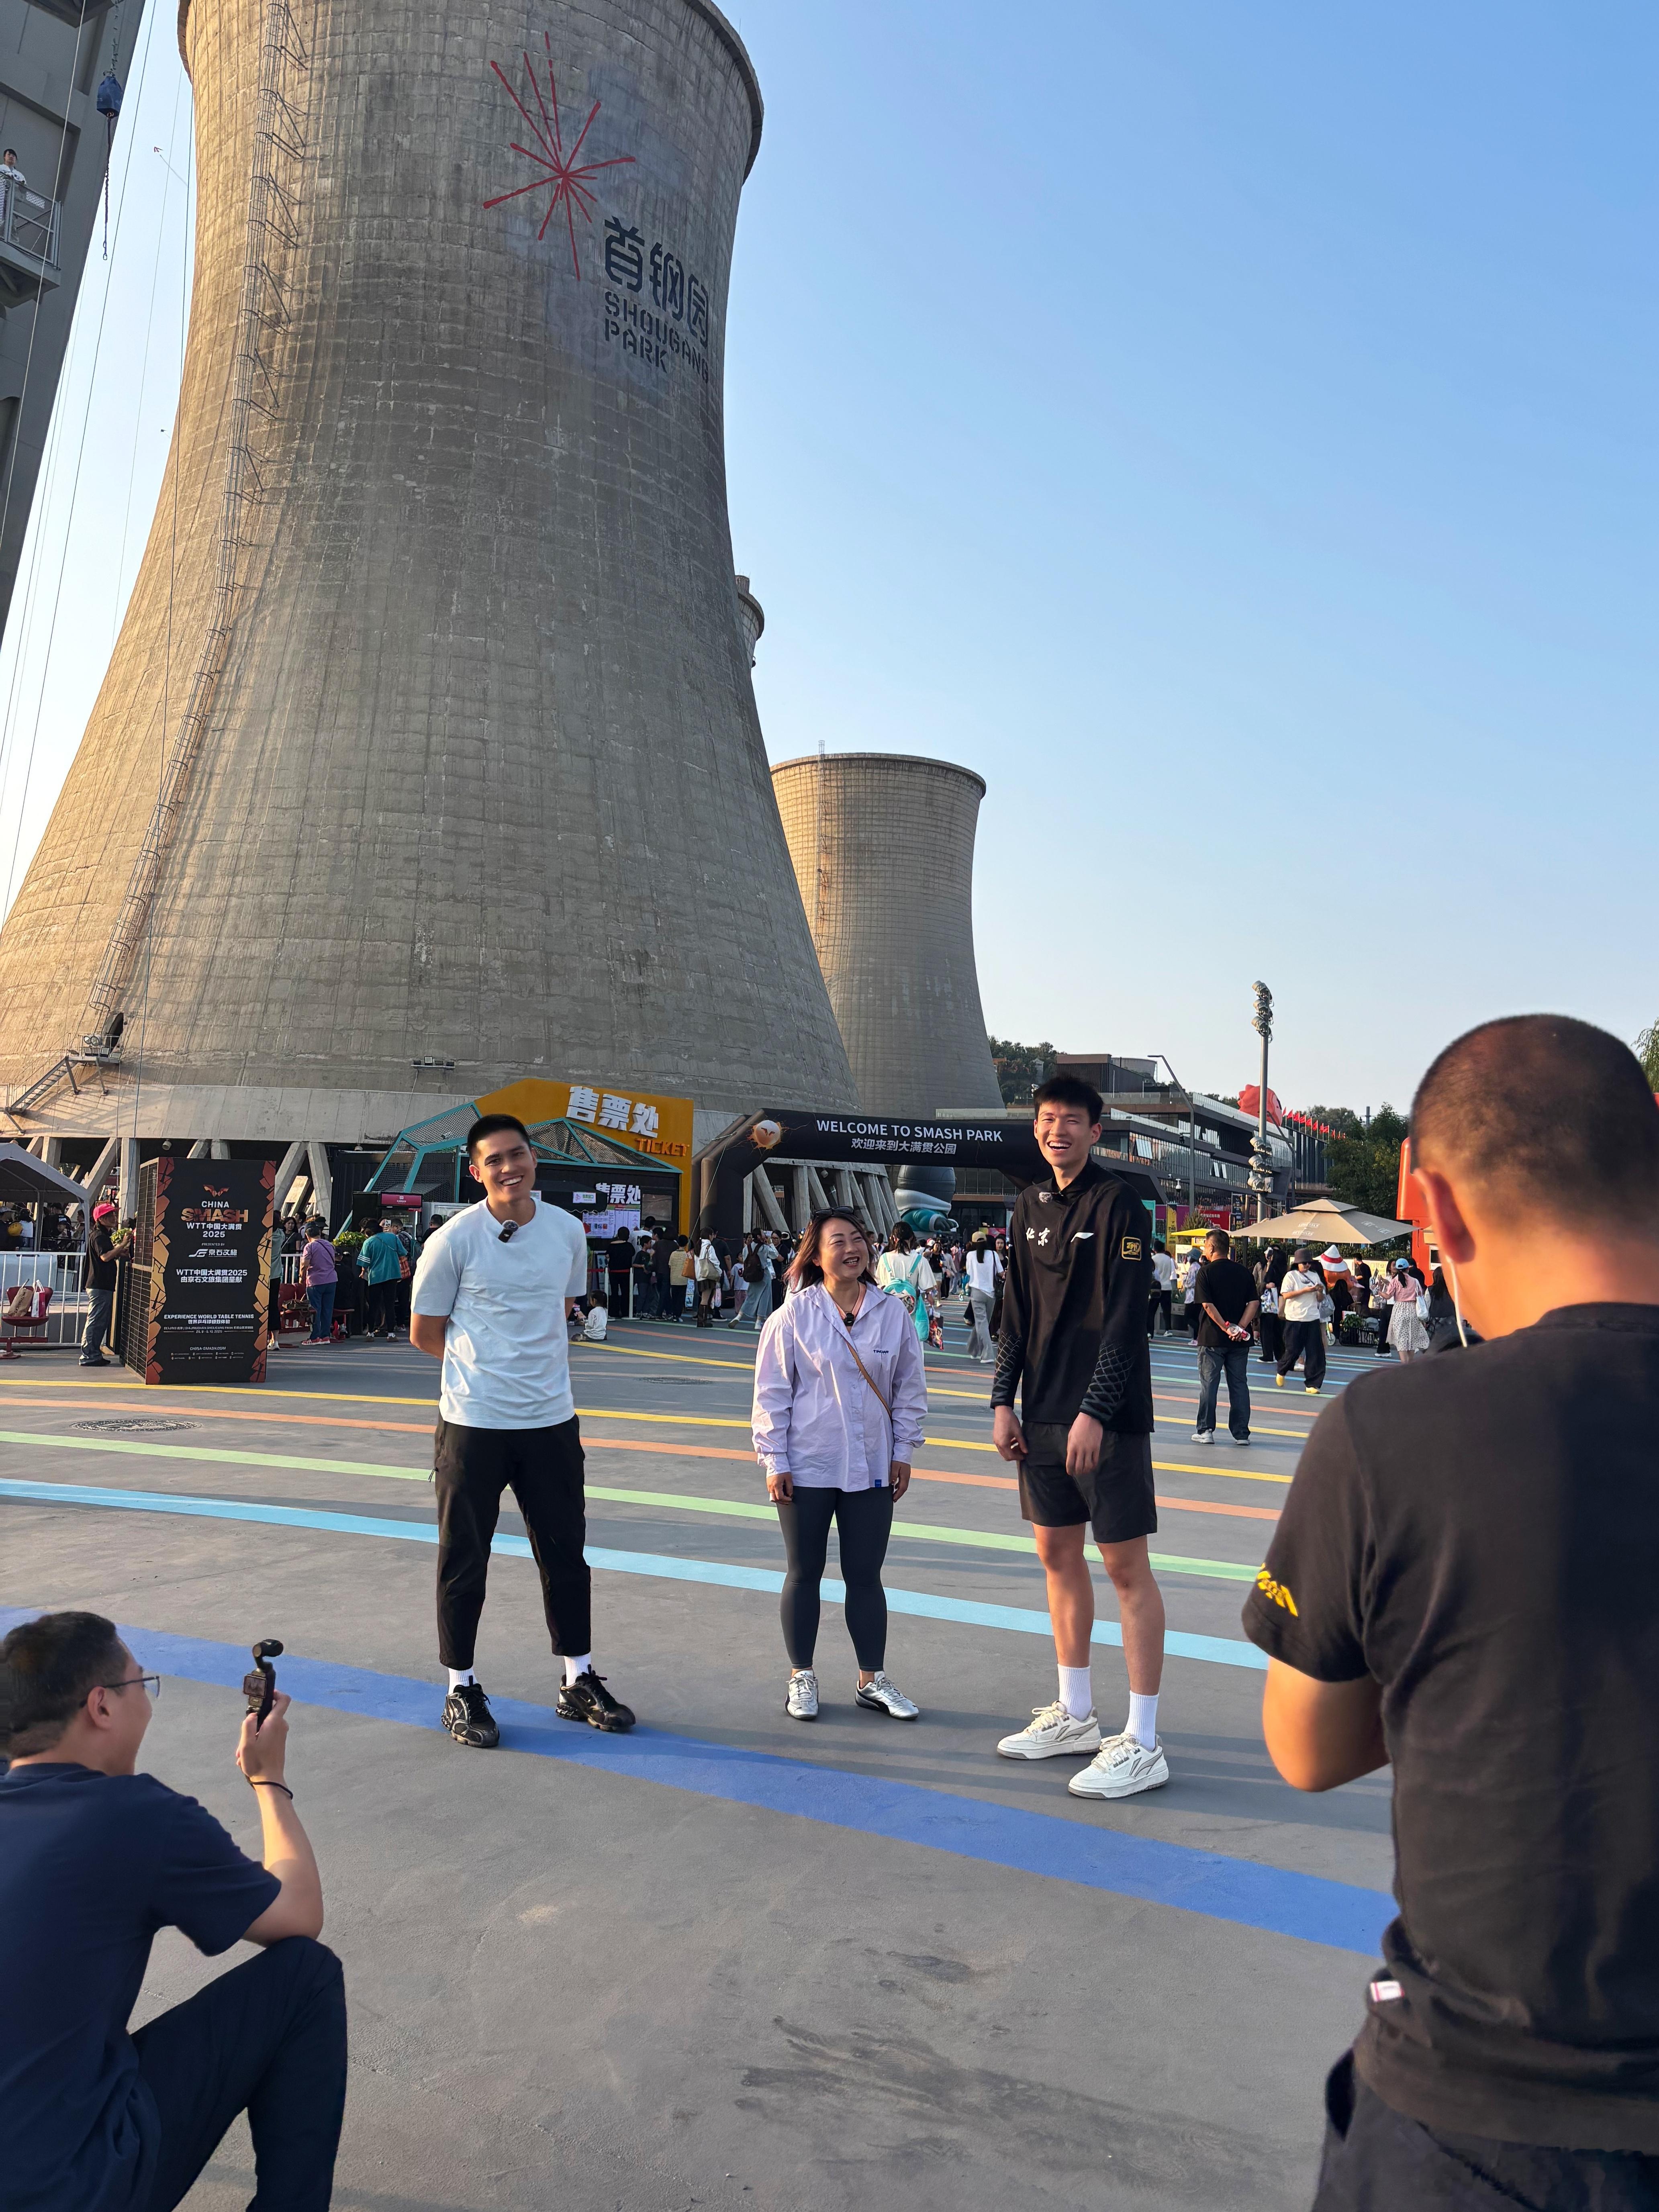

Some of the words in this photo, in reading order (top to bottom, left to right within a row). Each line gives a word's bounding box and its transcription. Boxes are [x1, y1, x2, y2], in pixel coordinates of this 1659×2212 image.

[604, 215, 709, 349] 首钢园
[605, 291, 709, 384] SHOUGANG
[605, 318, 668, 374] PARK
[566, 1086, 659, 1138] 售票处
[816, 1119, 888, 1136] WELCOME
[891, 1125, 910, 1137] TO
[914, 1127, 963, 1141] SMASH
[966, 1129, 1004, 1142] PARK
[635, 1138, 690, 1157] TICKET
[851, 1138, 957, 1155] 欢迎来到大满贯公园
[181, 1208, 249, 1223] SMASH
[1026, 1227, 1050, 1246] 北京
